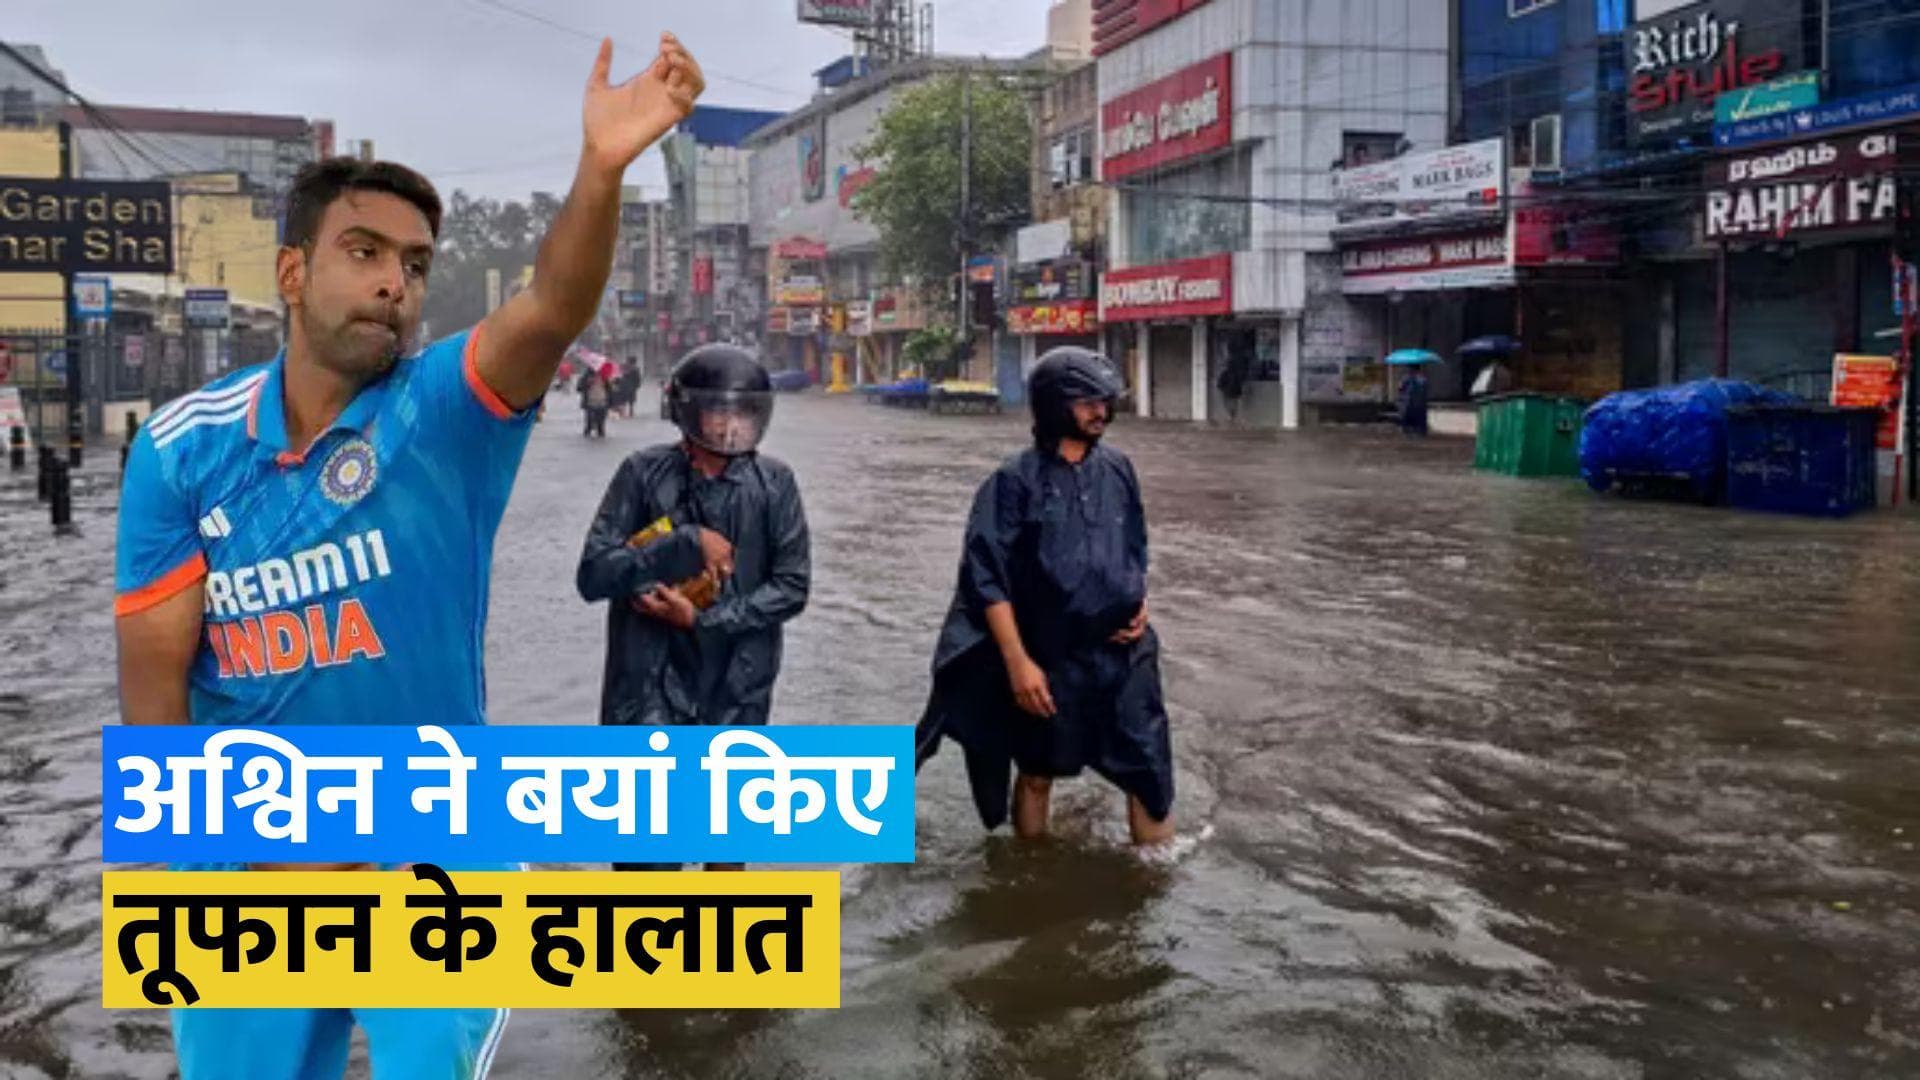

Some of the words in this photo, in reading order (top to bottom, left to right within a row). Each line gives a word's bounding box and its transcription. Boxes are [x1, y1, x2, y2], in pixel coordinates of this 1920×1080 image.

[1633, 12, 1720, 74] Rich
[0, 187, 164, 223] Garden
[1706, 183, 1834, 236] RAHIM
[82, 229, 166, 263] Sha
[1103, 275, 1179, 308] BOMBAY
[208, 598, 386, 678] INDIA
